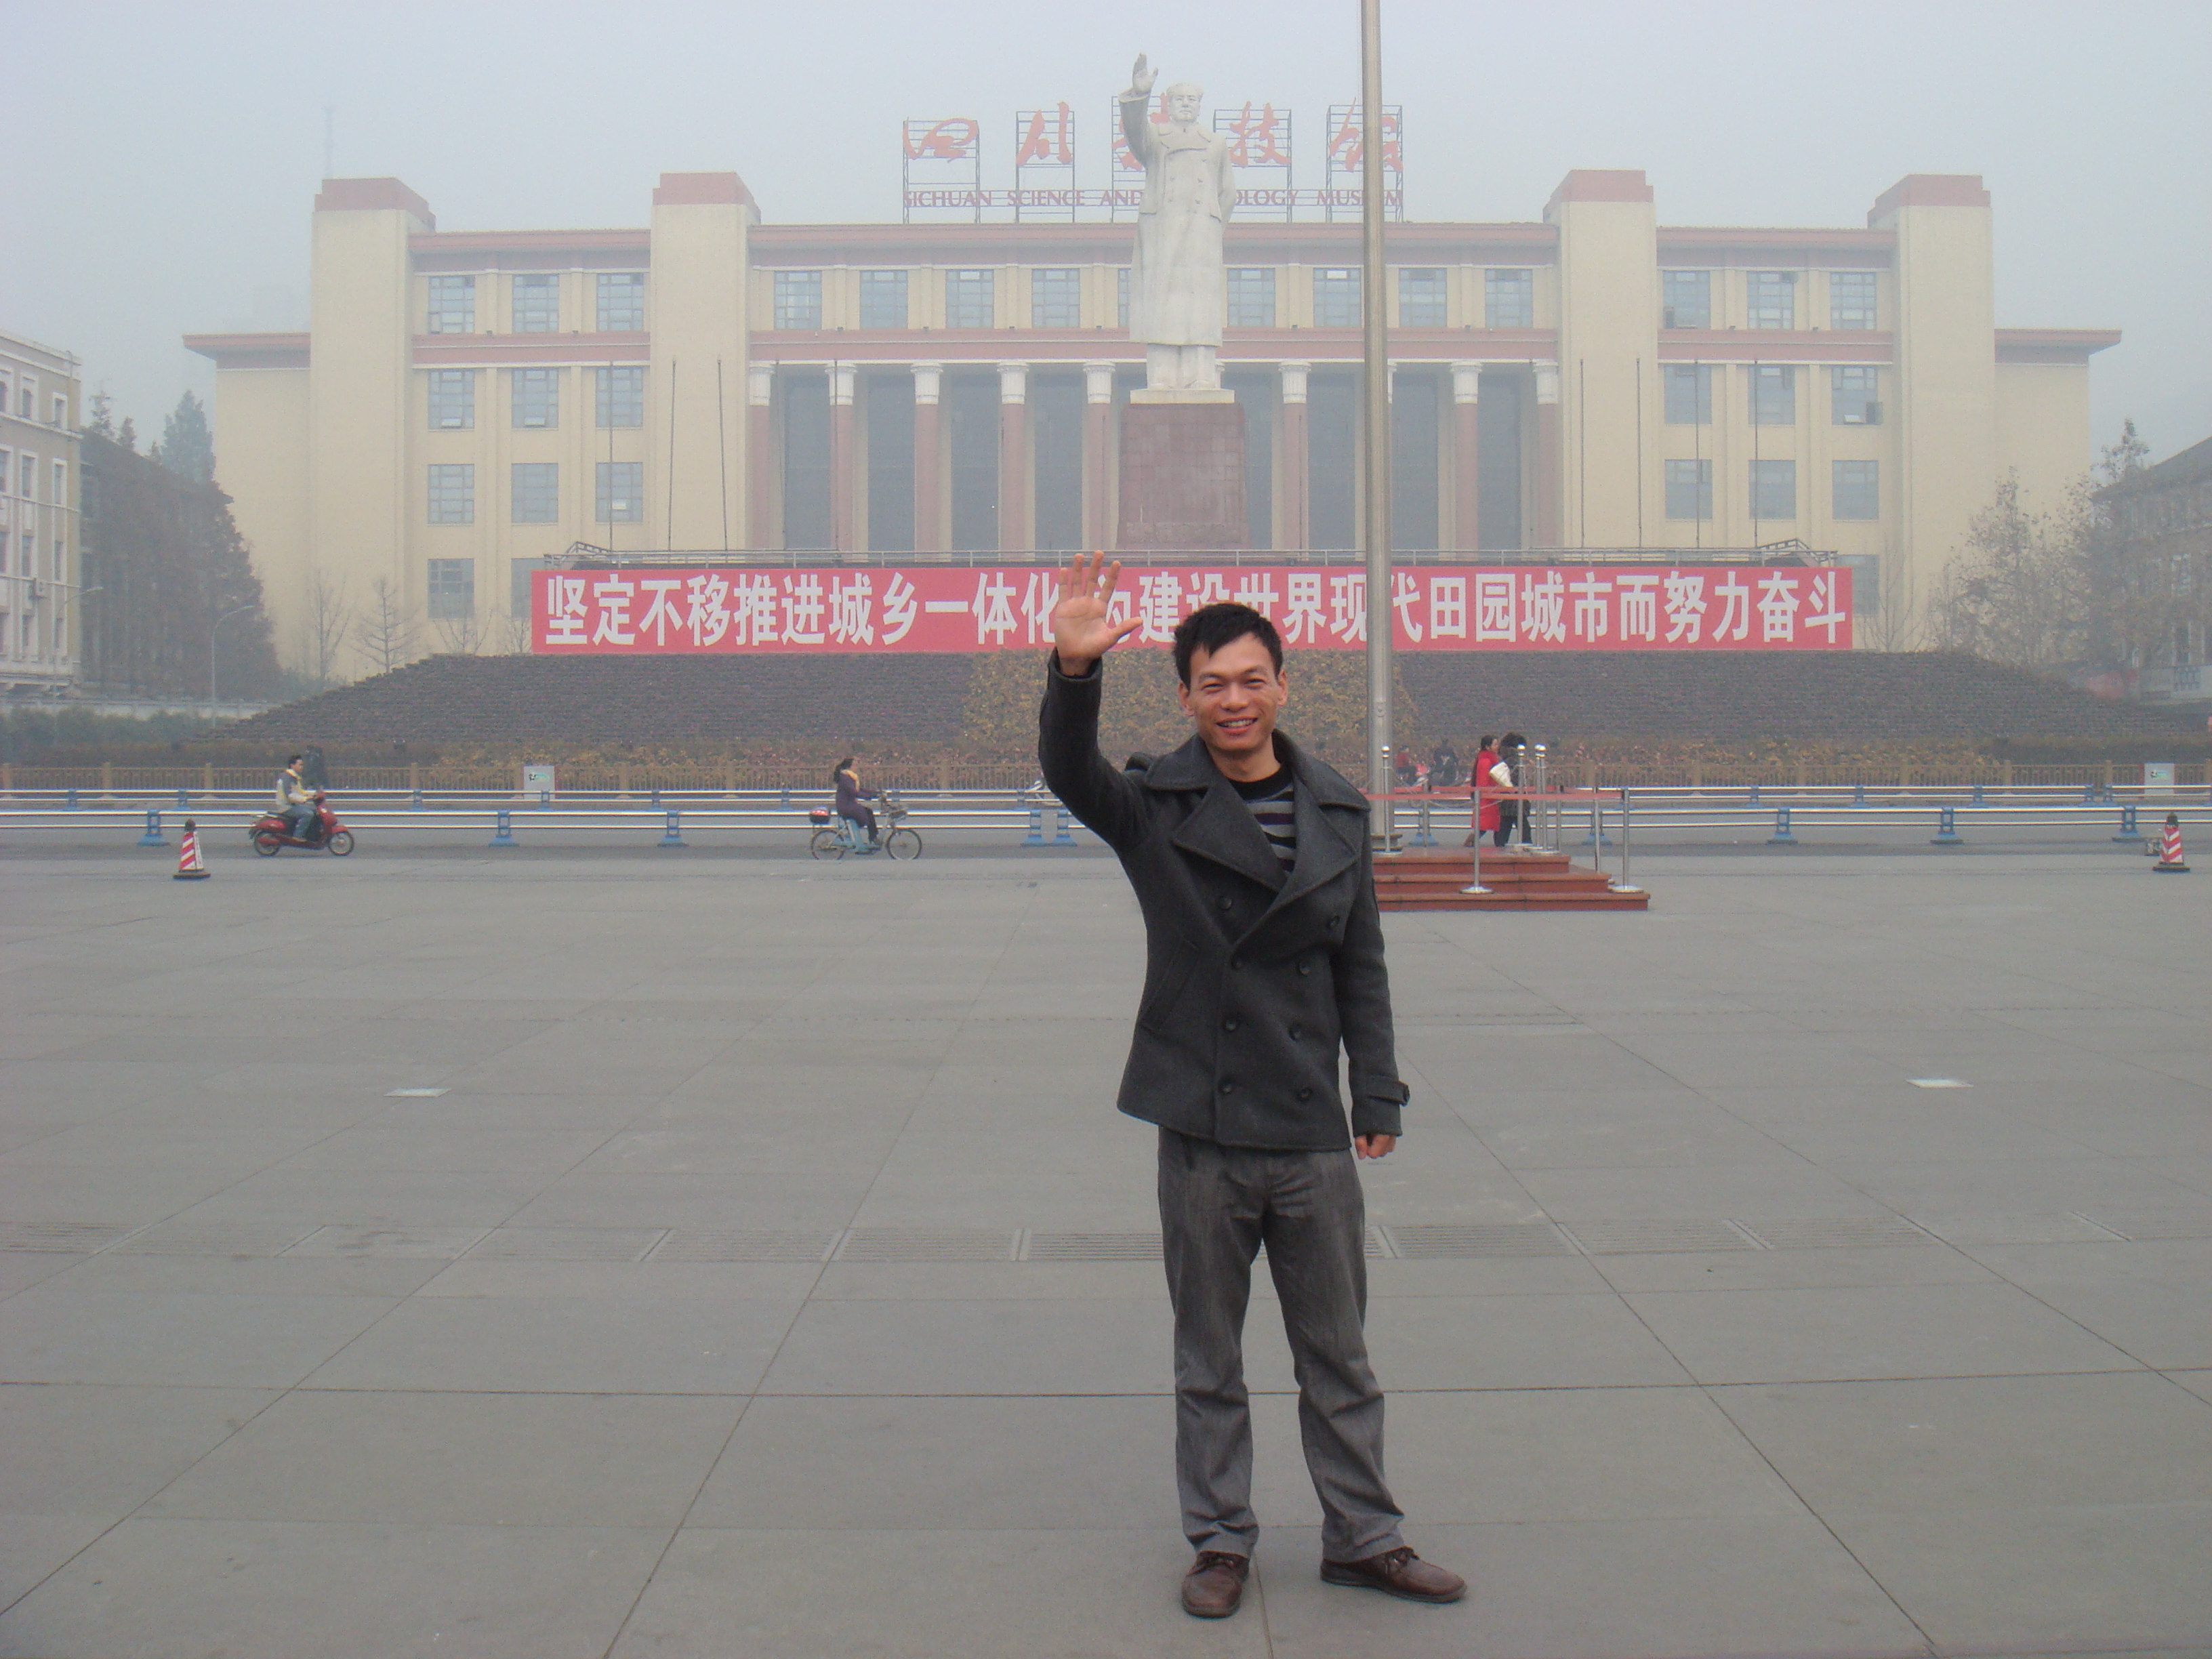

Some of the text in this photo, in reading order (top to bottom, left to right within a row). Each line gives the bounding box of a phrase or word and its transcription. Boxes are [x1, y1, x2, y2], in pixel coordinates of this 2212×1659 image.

[903, 190, 991, 206] SICHUAN
[1007, 190, 1085, 206] SCIENCE
[1100, 190, 1144, 206] AND
[1317, 190, 1402, 205] MUSM
